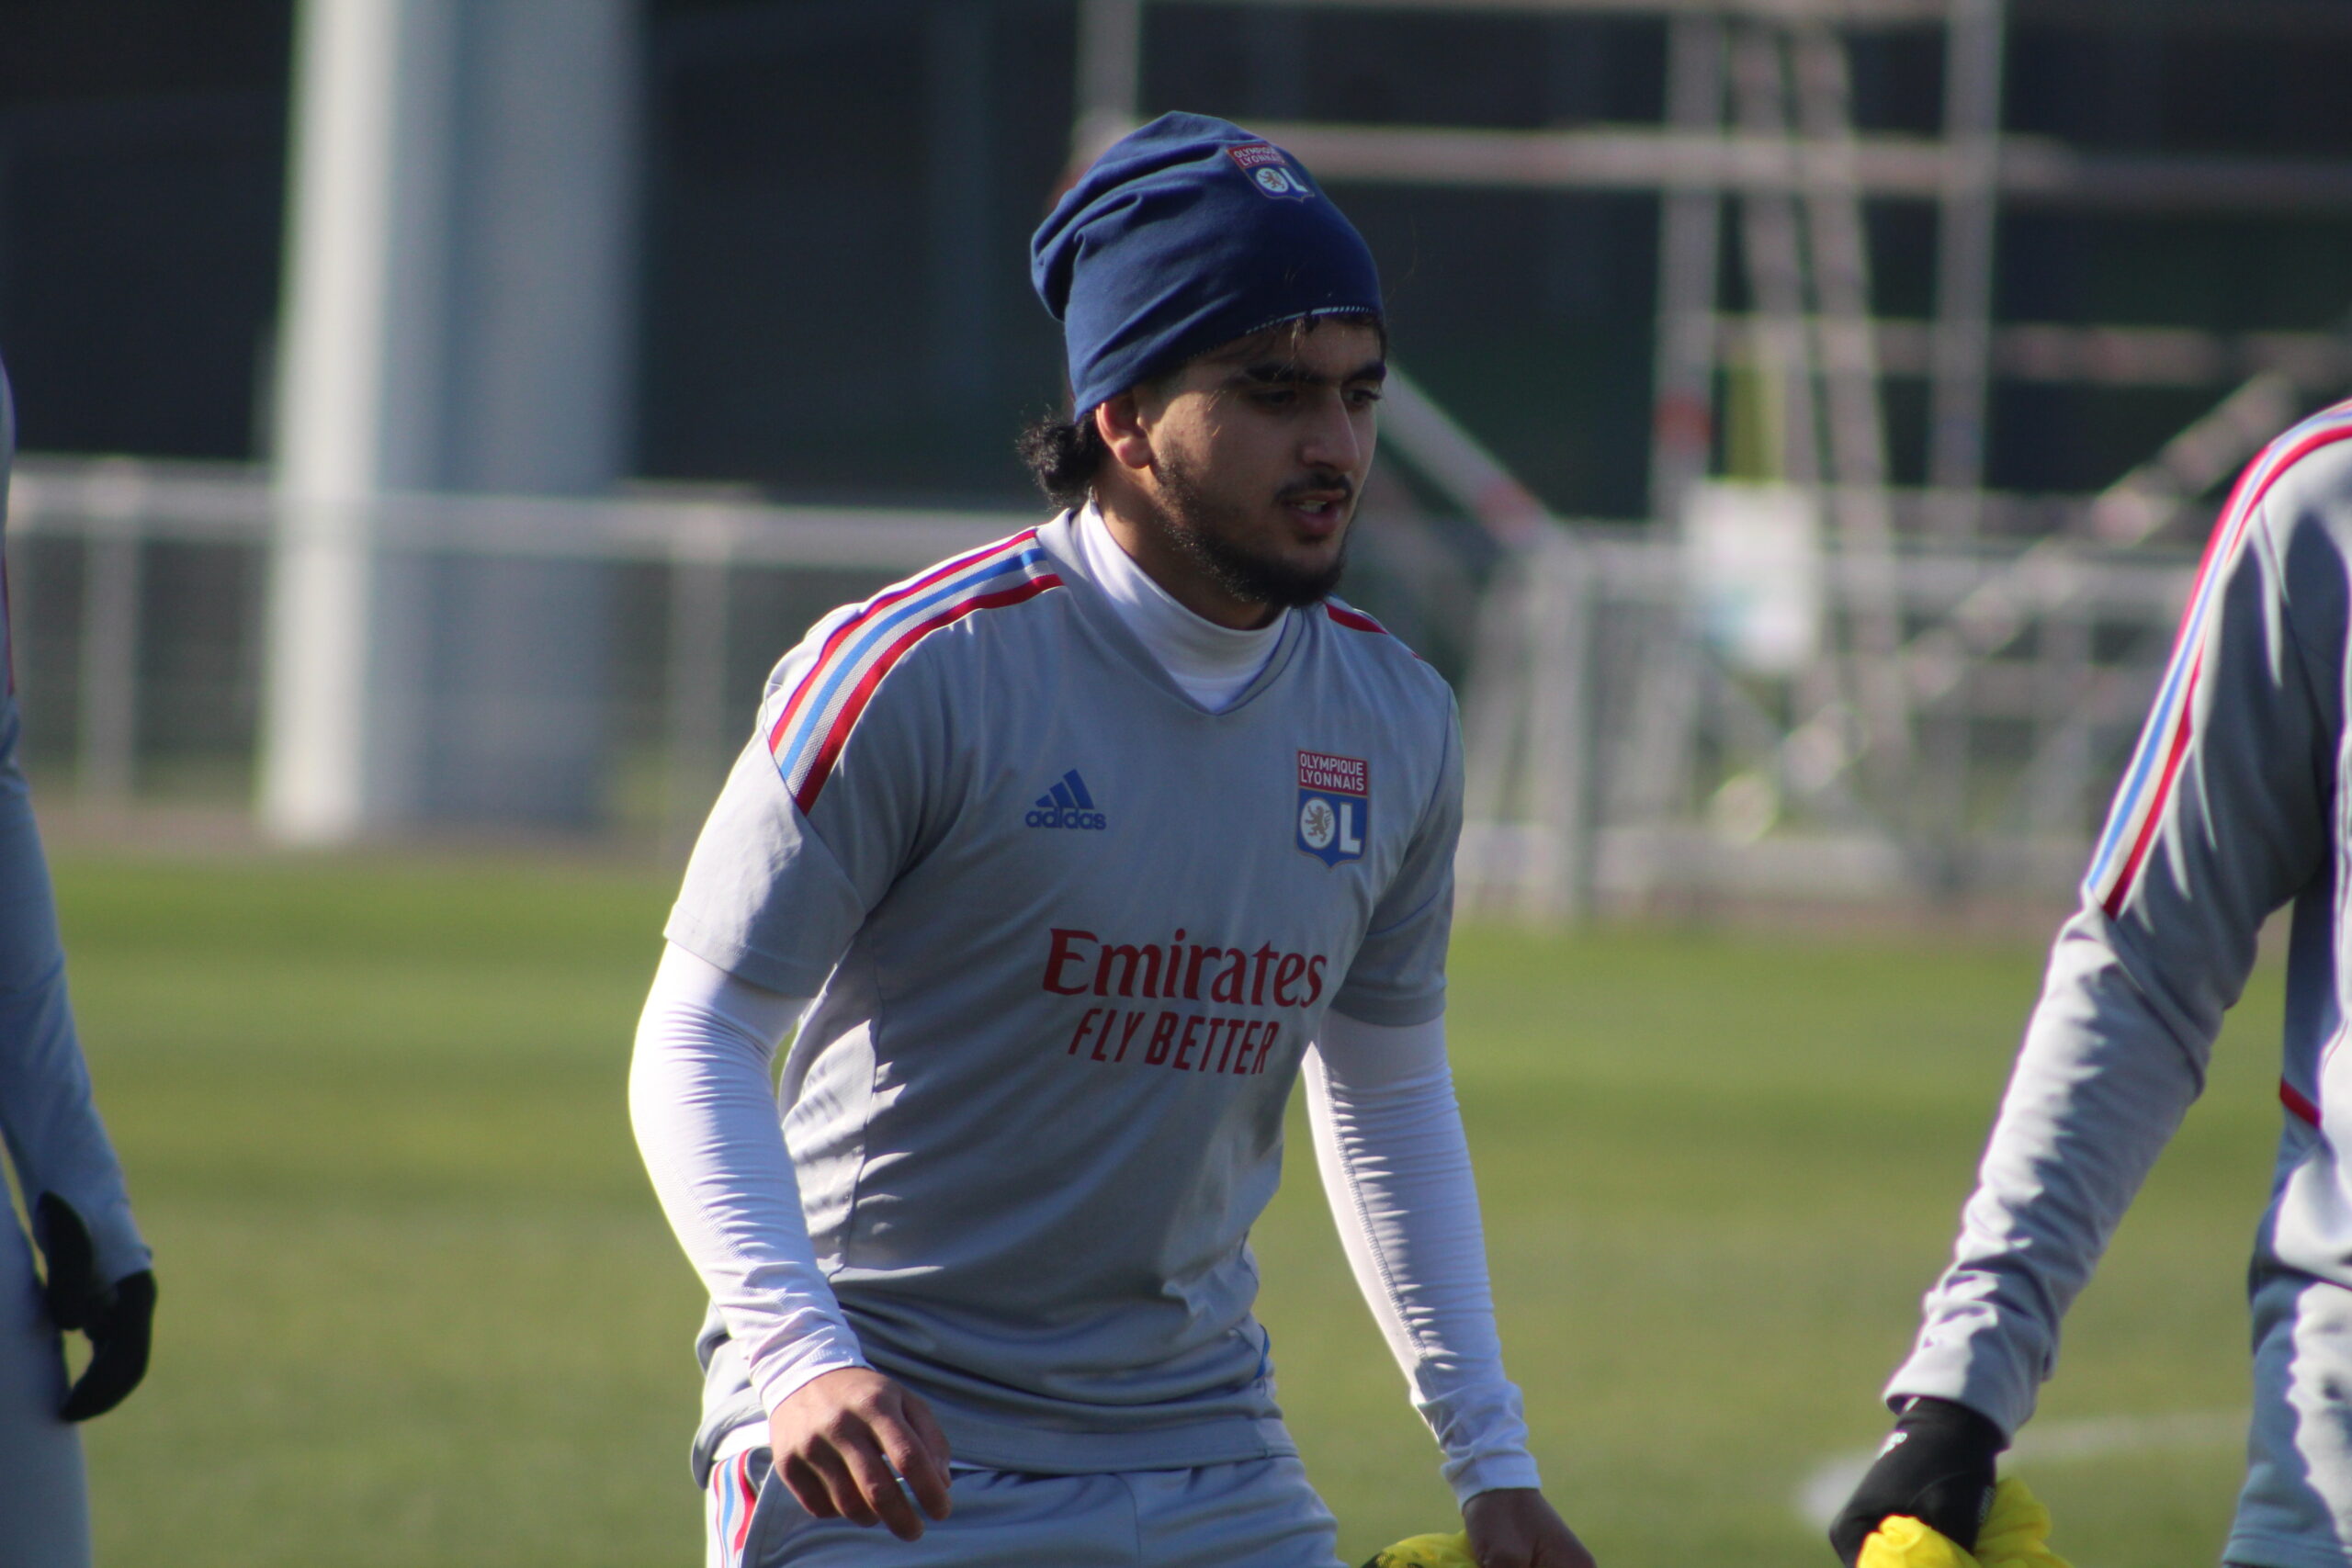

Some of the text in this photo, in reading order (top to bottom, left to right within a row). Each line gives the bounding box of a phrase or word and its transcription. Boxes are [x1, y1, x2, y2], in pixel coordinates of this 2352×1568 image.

[1234, 146, 1278, 158] OLYMP
[1239, 152, 1285, 166] LYONN
[1300, 753, 1363, 776] OLYMPIQUE
[1301, 769, 1364, 791] LYONNAIS
[1025, 806, 1107, 830] adidas
[1300, 798, 1361, 854] OL
[1043, 927, 1328, 1009] Emirates
[1069, 1009, 1280, 1075] FLY BETTER
